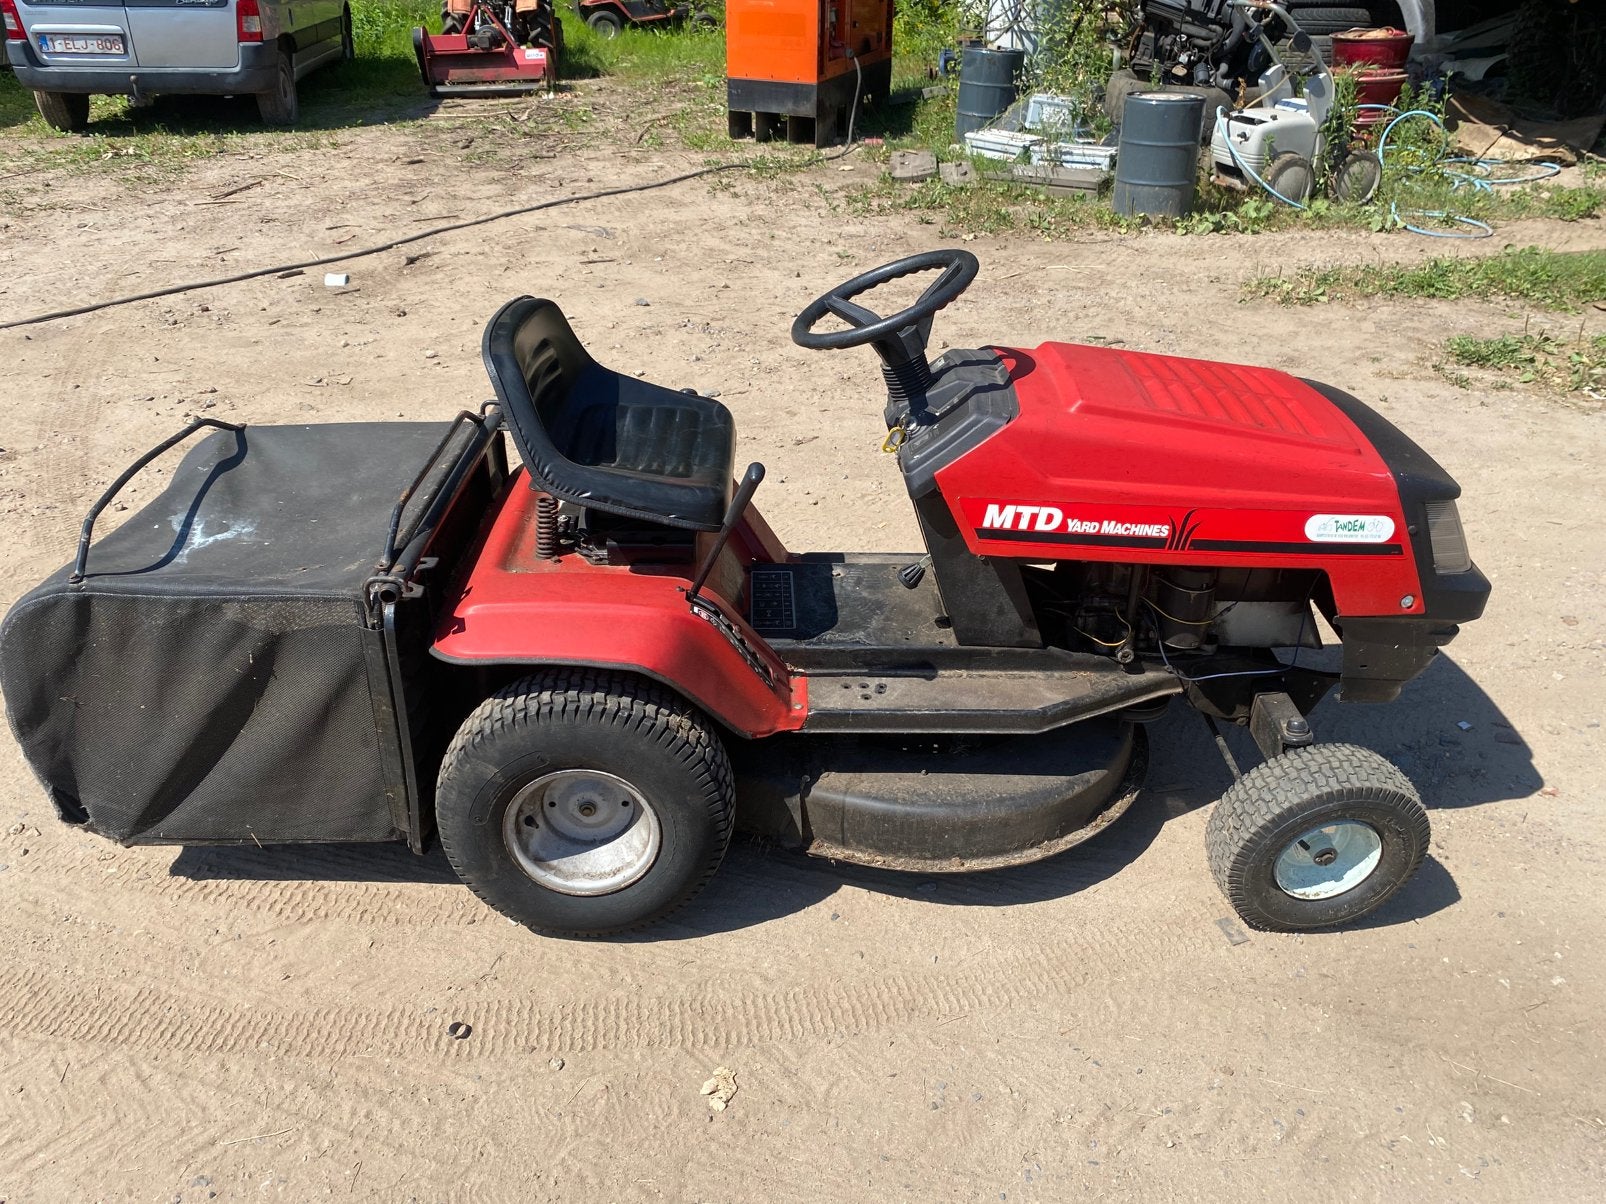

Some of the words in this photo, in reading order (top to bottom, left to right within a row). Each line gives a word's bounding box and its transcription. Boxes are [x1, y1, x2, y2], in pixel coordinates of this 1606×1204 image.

[49, 36, 121, 51] 1-ELJ-806
[982, 504, 1063, 531] MTD
[1067, 519, 1100, 533] YARD
[1100, 520, 1170, 537] MACHINES
